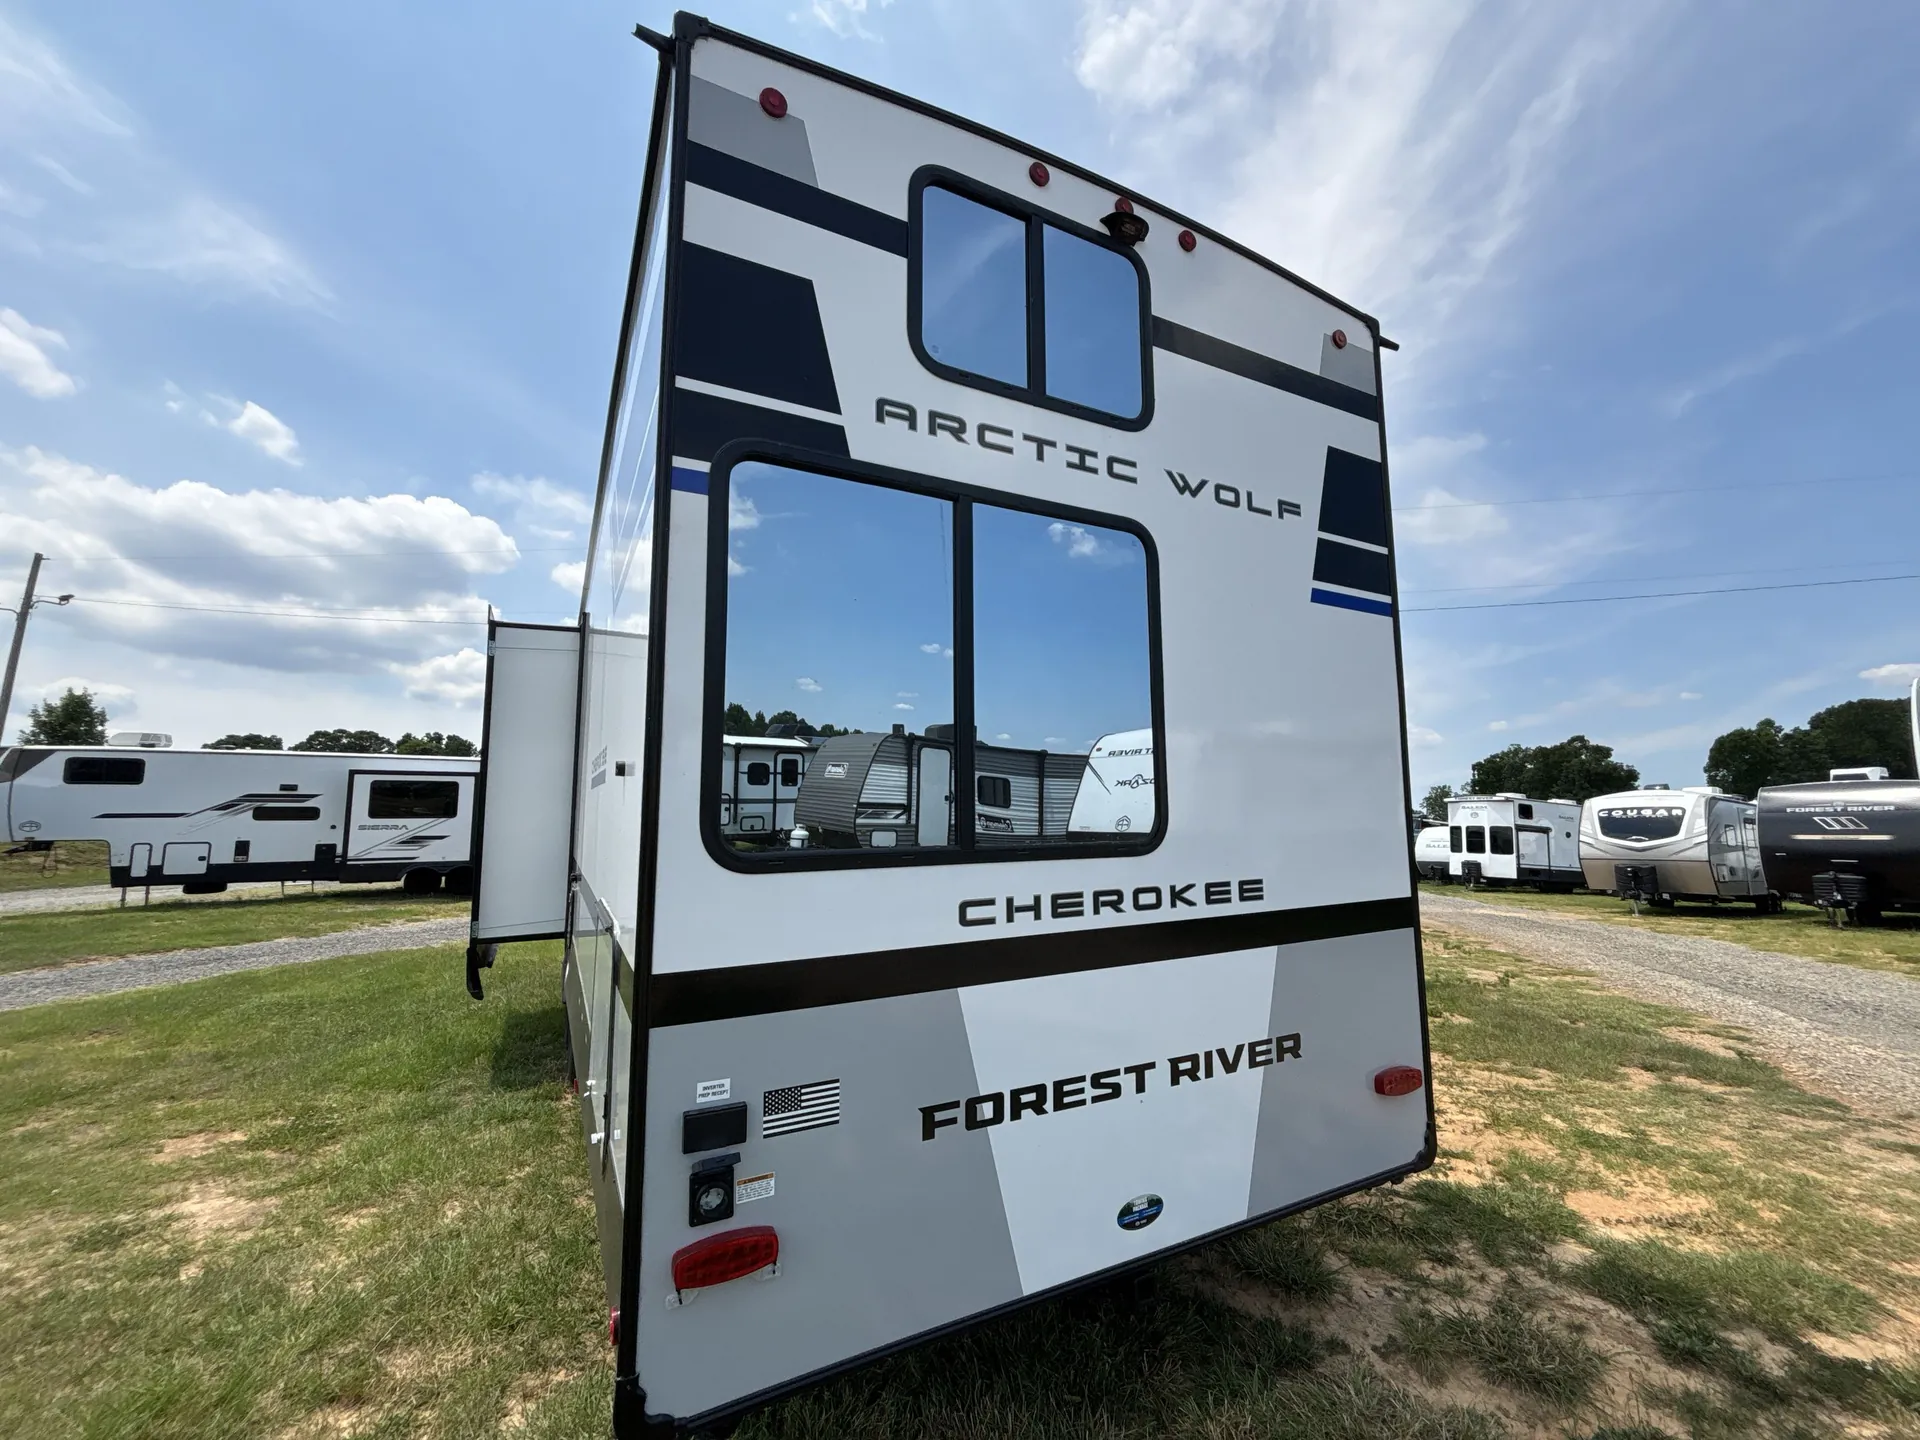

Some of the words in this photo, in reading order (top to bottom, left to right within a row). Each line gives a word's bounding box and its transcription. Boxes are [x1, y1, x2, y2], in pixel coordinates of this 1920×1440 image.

[875, 396, 1138, 485] ARCTIC
[1163, 467, 1302, 520] WOLF
[1598, 808, 1683, 817] COUGAR
[958, 878, 1265, 928] CHEROKEE
[702, 1083, 724, 1091] INVERTER
[917, 1060, 1157, 1142] FOREST
[1166, 1032, 1303, 1087] RIVER
